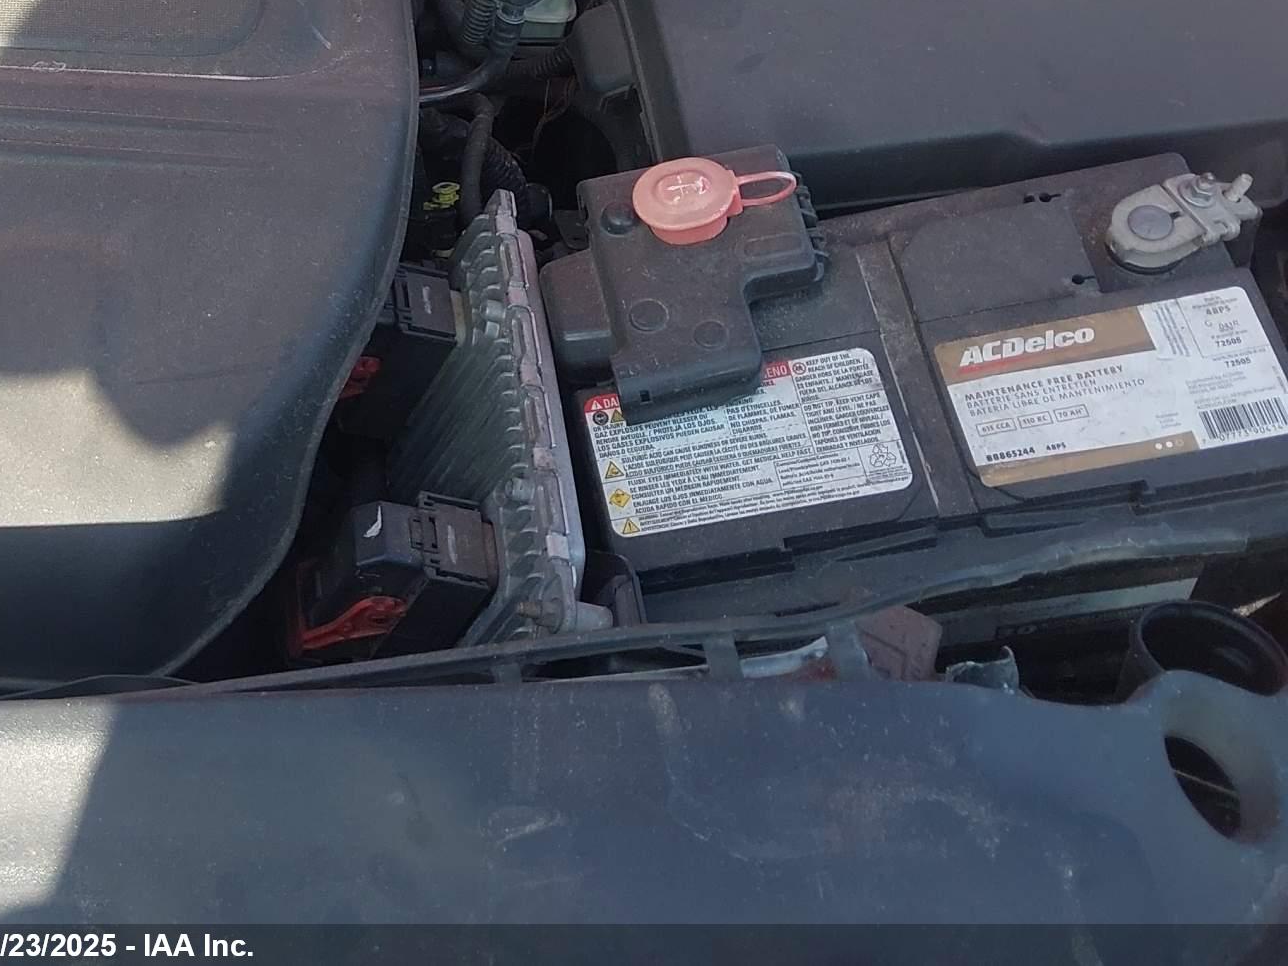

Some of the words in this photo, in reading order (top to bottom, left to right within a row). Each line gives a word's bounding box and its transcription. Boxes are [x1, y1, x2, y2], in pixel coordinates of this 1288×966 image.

[959, 326, 1095, 368] ACDelco
[807, 364, 825, 372] REACH
[964, 379, 1043, 400] MAINTENANCE
[1046, 374, 1073, 385] FREE
[1075, 365, 1123, 380] BATTERY
[864, 392, 880, 400] CAPS
[966, 394, 1011, 408] BATTERIE
[1013, 388, 1040, 399] SANS
[1041, 378, 1096, 394] ENTRETIEN
[1012, 397, 1039, 408] LIBRE
[1058, 377, 1145, 400] MANTENIMIENTO
[674, 446, 691, 454] CAUSE
[647, 474, 662, 482] EYES
